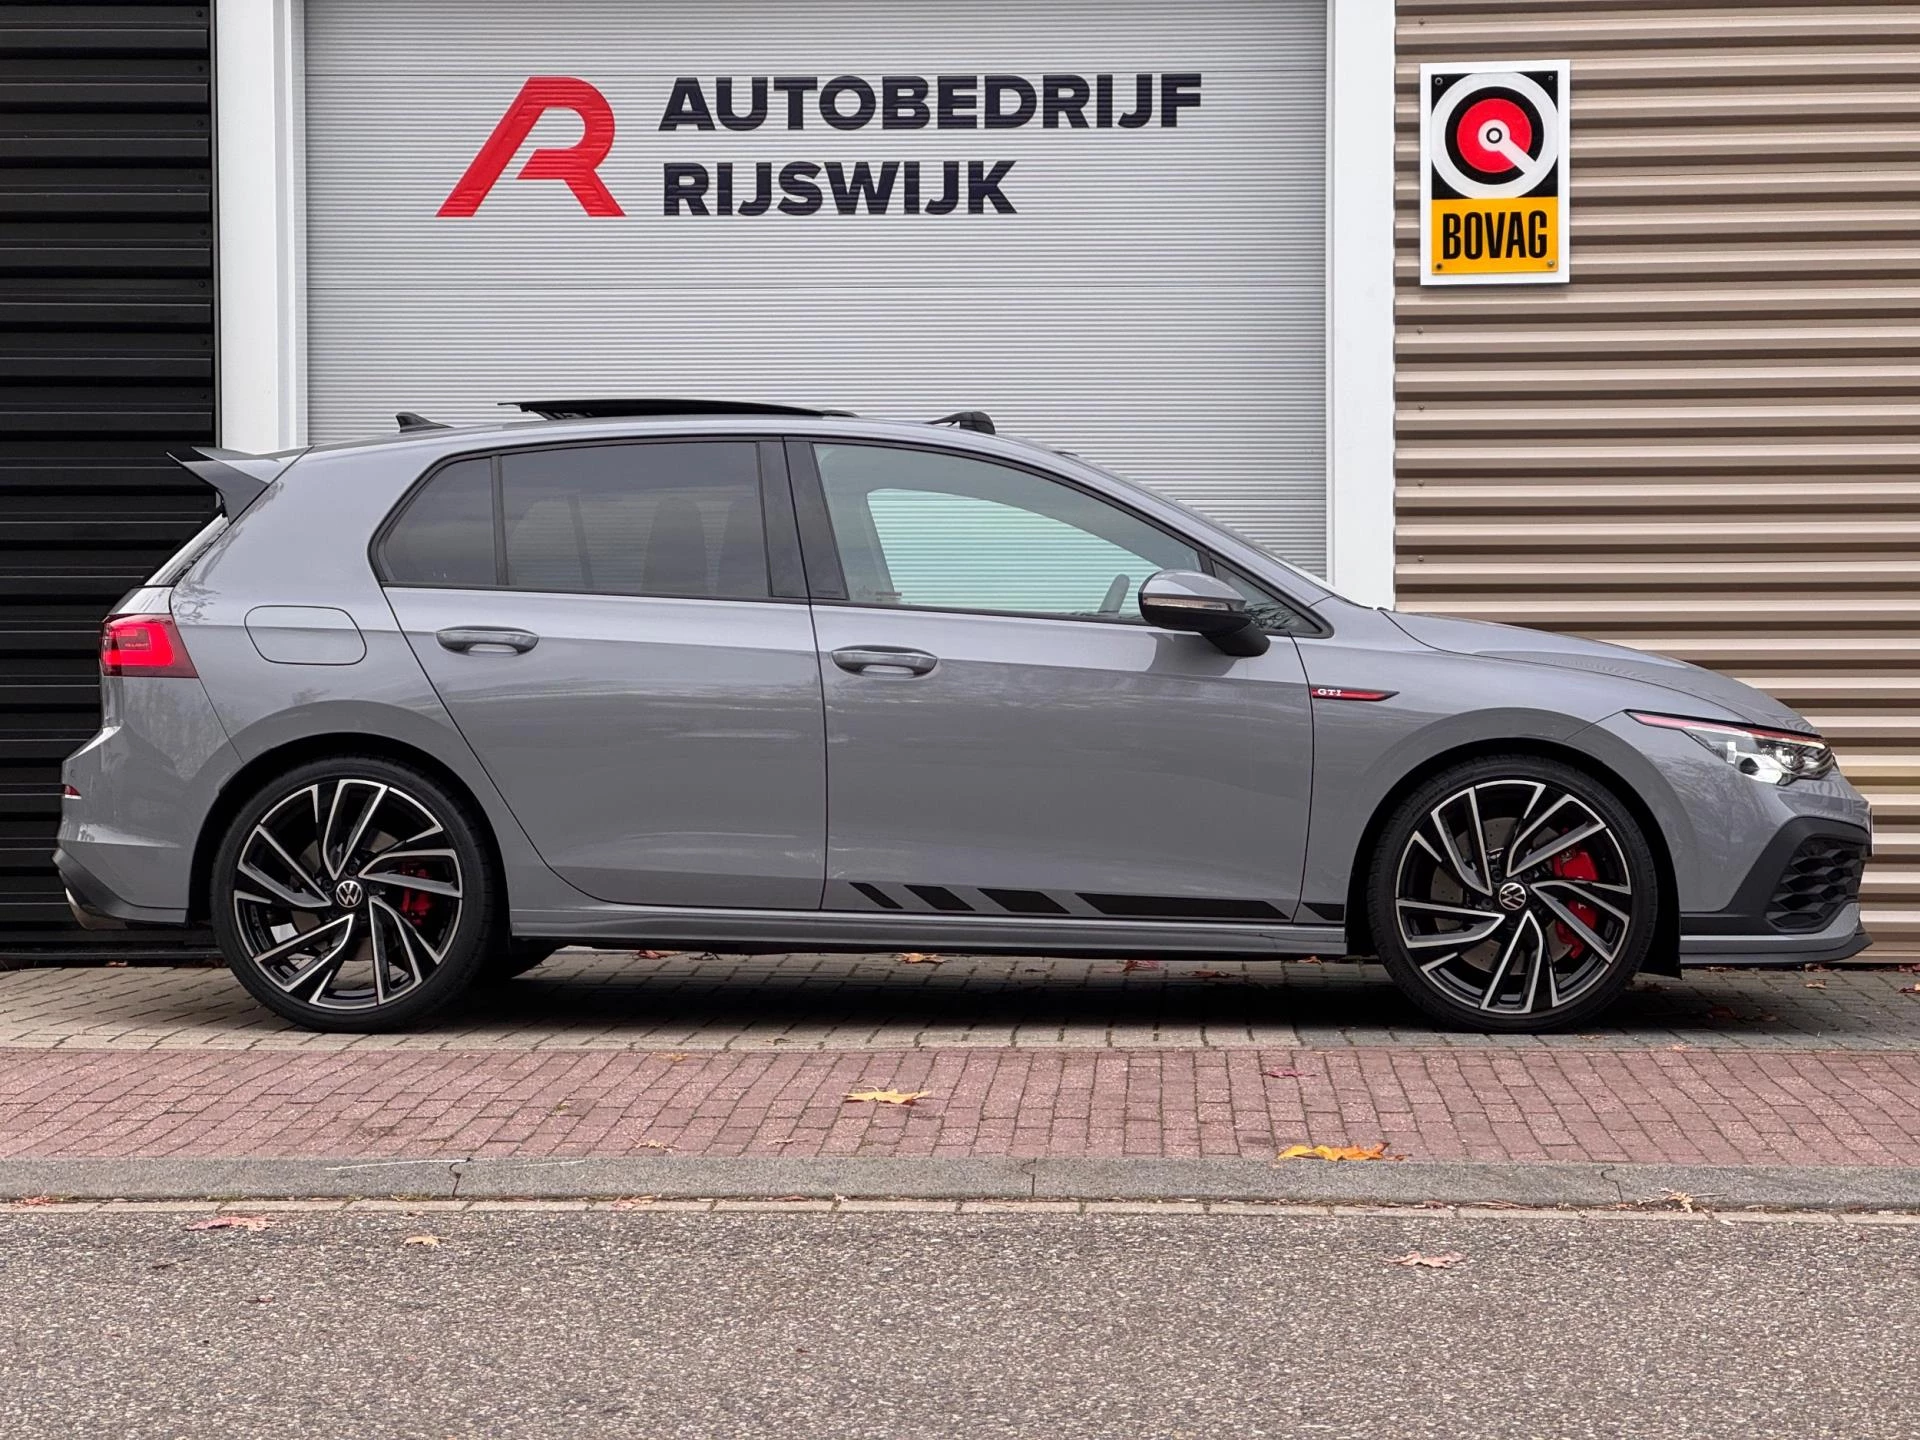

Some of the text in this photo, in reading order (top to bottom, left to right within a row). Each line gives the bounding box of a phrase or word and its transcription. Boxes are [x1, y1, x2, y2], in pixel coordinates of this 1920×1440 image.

[659, 74, 1202, 132] AUTOBEDRIJF
[664, 161, 1017, 216] RIJSWIJK
[1442, 210, 1548, 260] BOVAG
[1317, 688, 1342, 697] GTI
